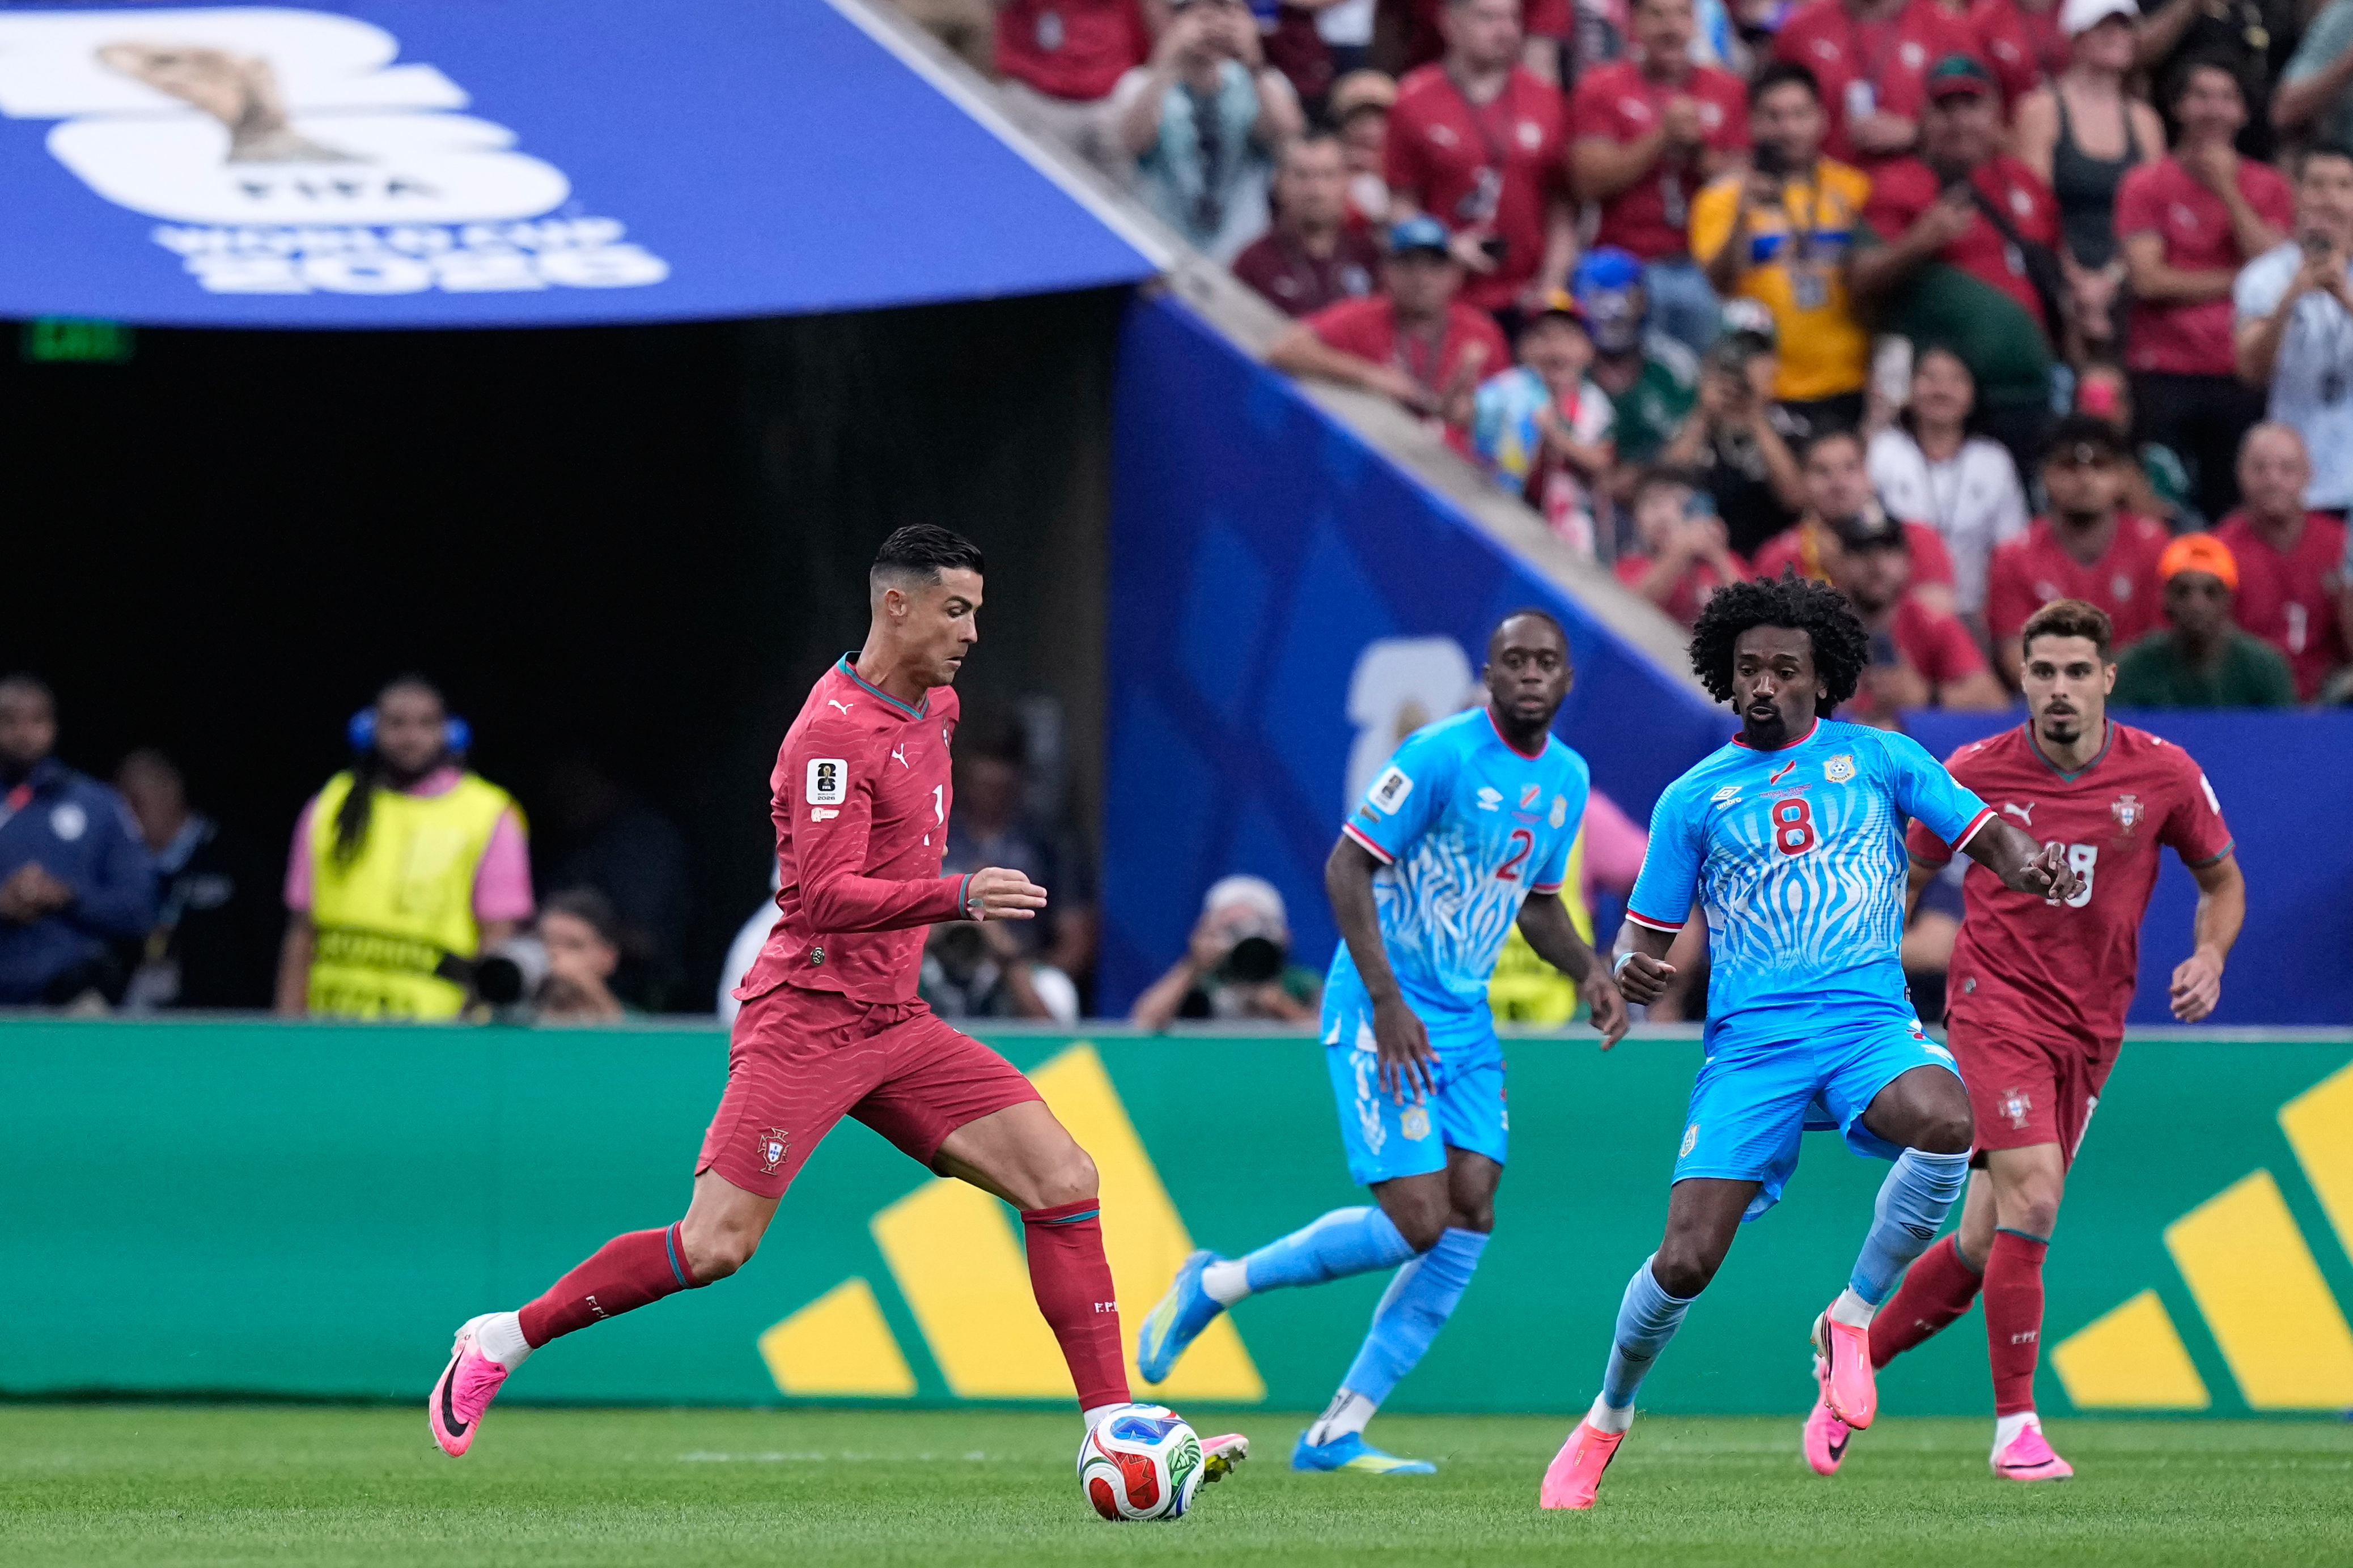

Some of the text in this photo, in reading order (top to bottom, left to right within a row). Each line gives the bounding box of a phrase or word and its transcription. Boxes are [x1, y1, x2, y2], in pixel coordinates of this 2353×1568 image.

[1716, 797, 1742, 810] umbro
[1772, 798, 1815, 856] 8
[1495, 828, 1532, 882] 2
